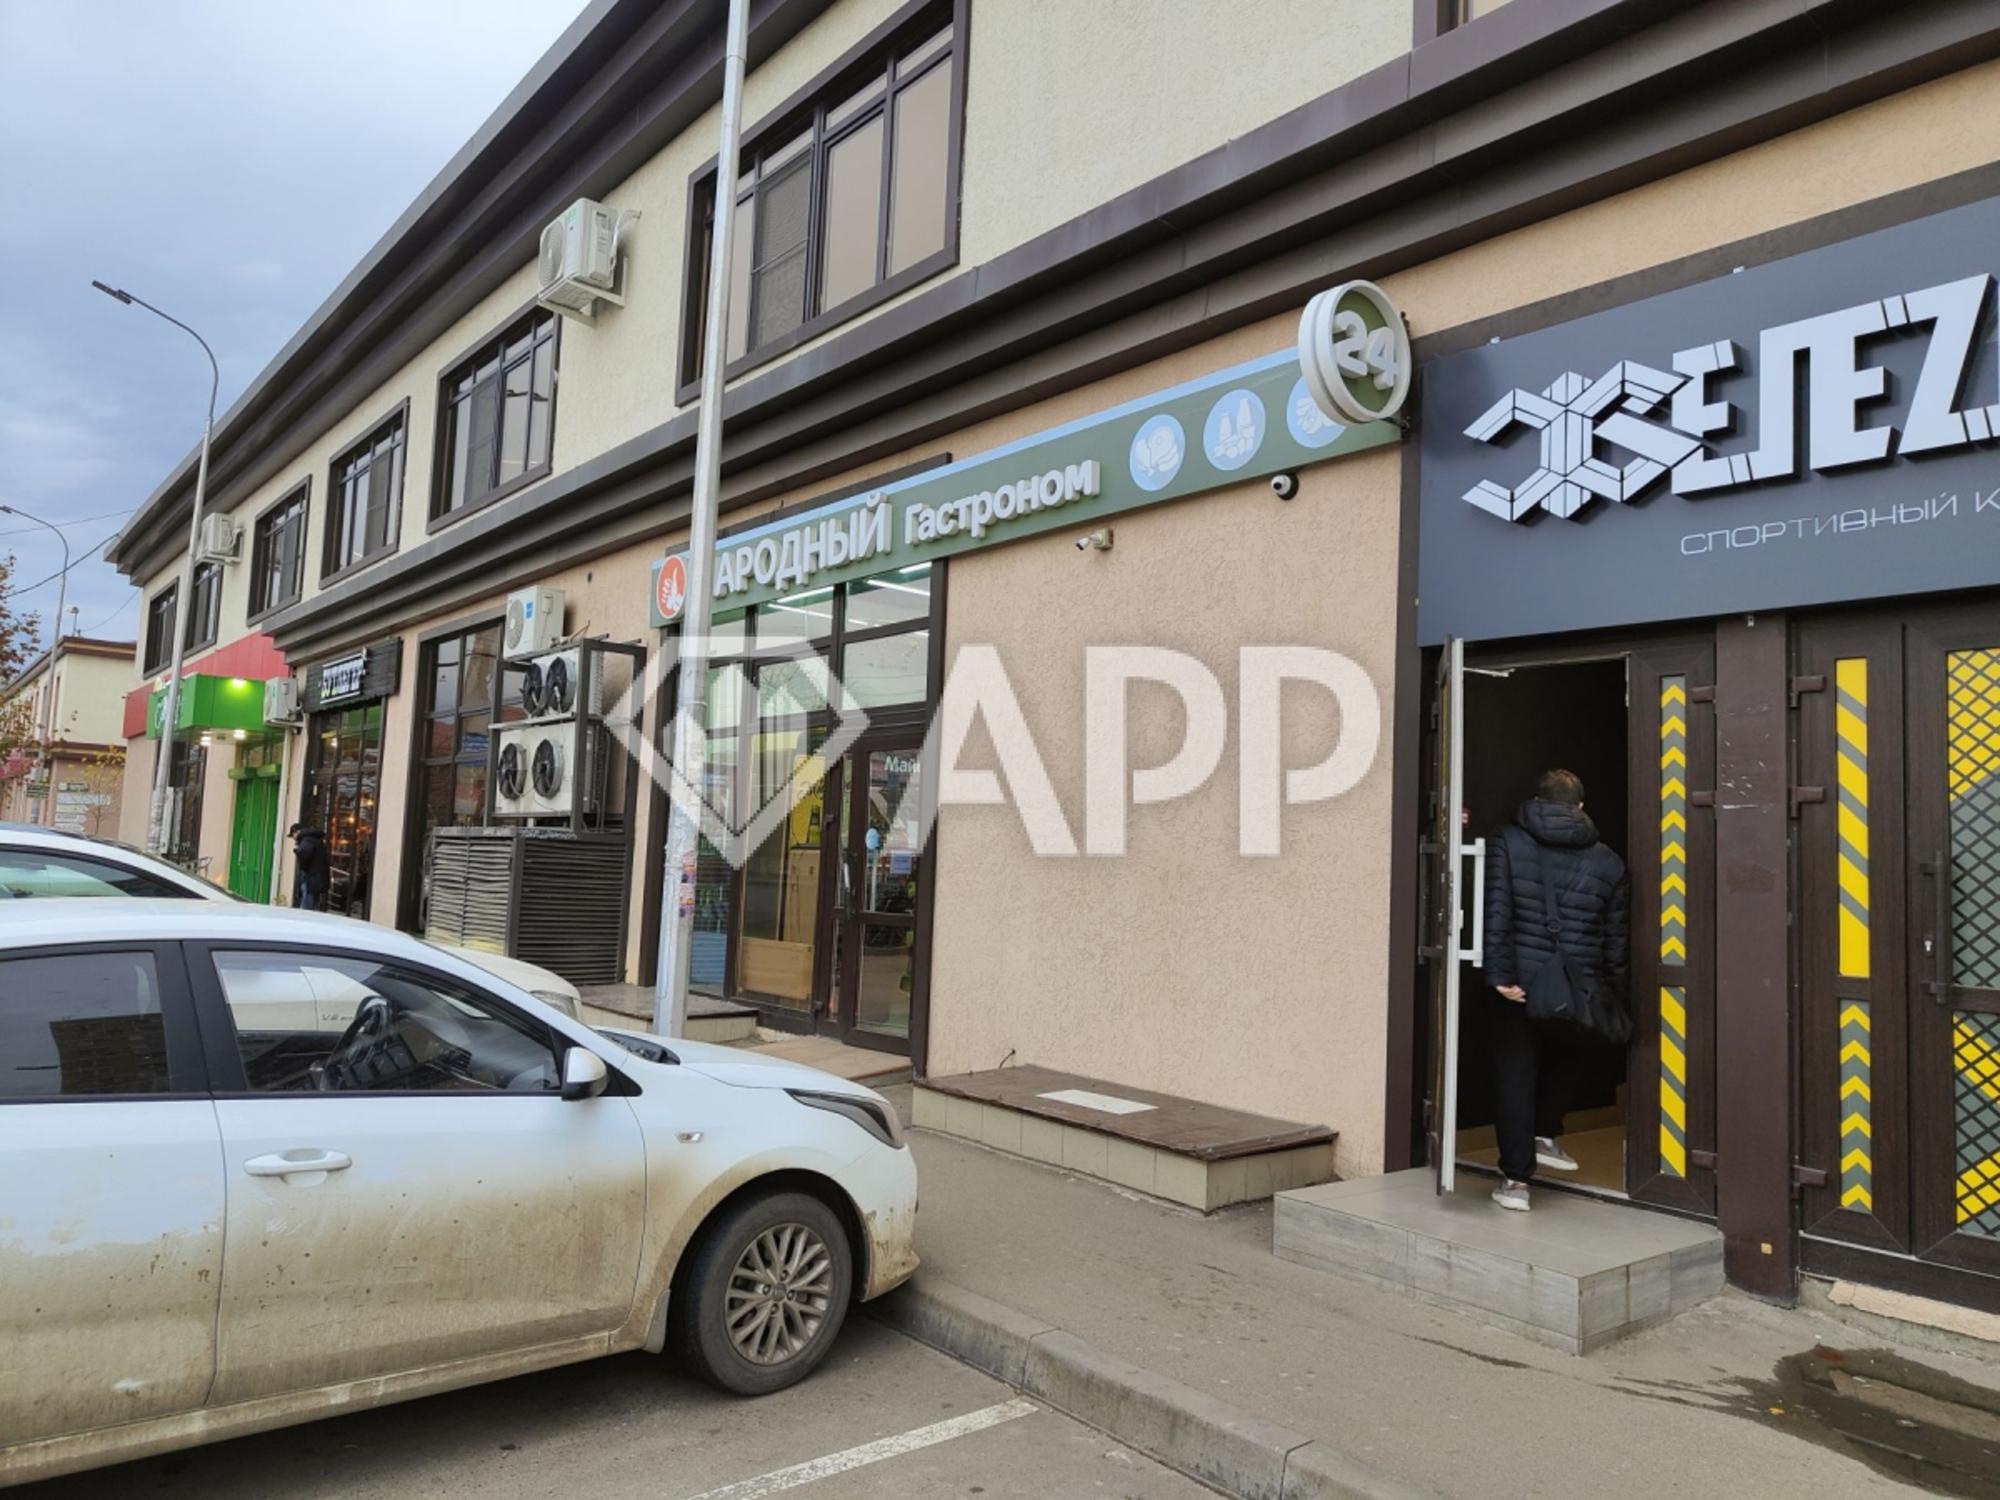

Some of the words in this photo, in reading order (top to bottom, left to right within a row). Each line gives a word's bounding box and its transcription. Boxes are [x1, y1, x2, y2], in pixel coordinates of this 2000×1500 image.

[1333, 310, 1399, 390] 24
[1462, 273, 2000, 522] ЖЕЛЕZ
[712, 491, 893, 599] АРОДНЫЙ
[904, 459, 1100, 547] Гастроном
[1680, 491, 1958, 556] СПОРТИВНЫЙ
